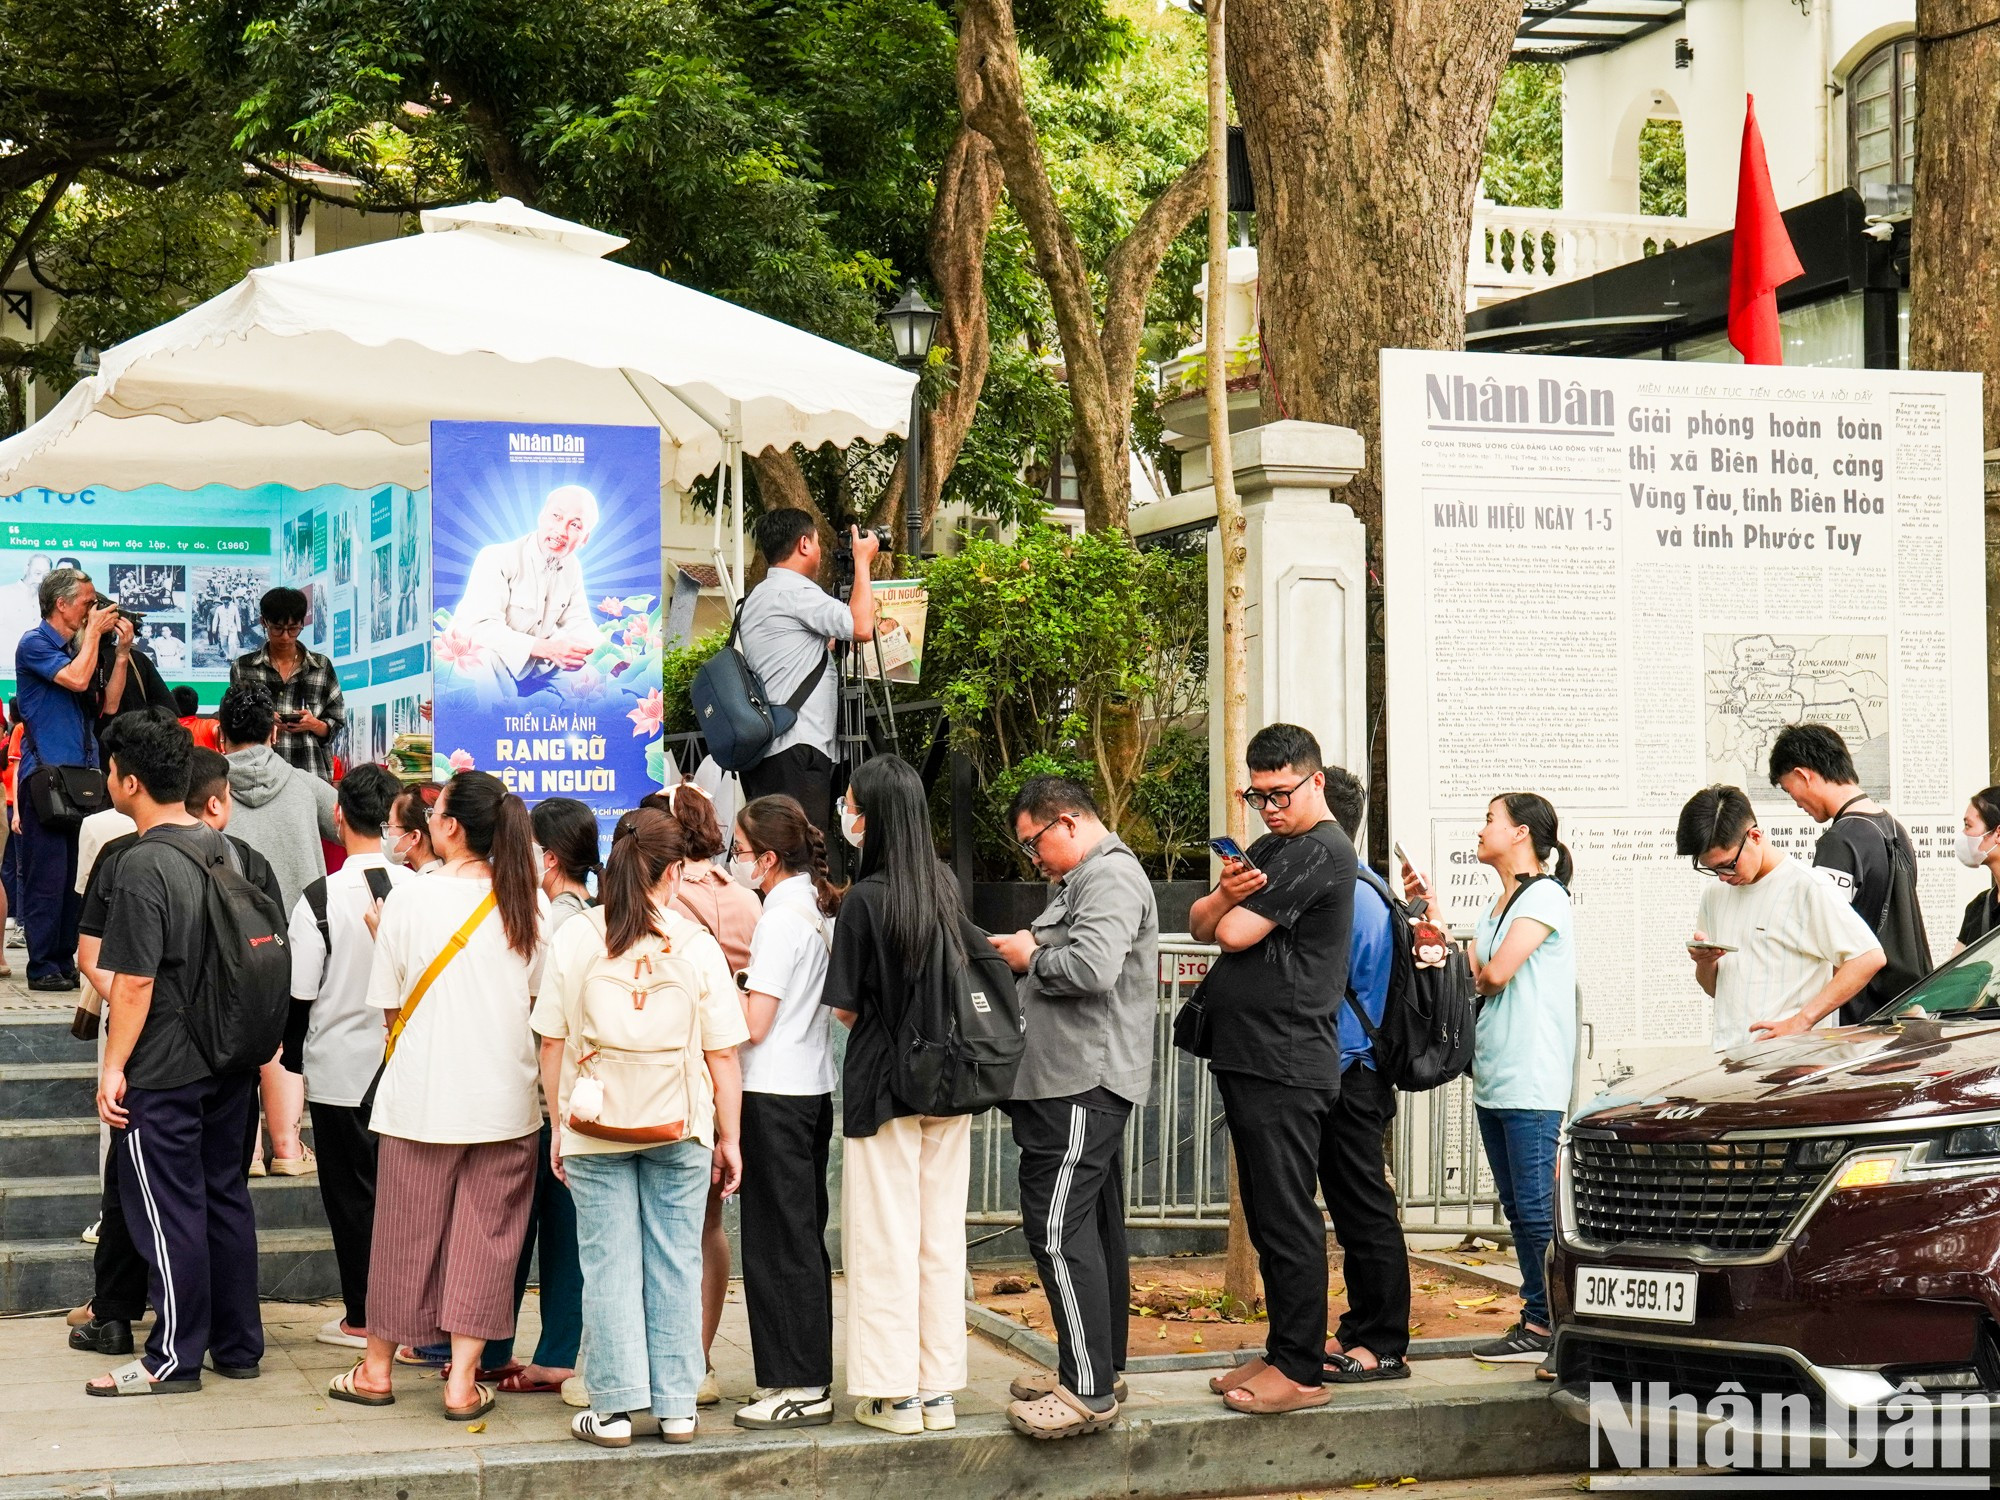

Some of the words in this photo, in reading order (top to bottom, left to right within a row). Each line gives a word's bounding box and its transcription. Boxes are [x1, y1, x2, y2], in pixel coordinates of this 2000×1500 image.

[1426, 373, 1529, 423] Nhân
[1539, 378, 1614, 426] Dân
[1628, 406, 1671, 433] Giải
[1687, 409, 1754, 440] phóng
[1769, 412, 1821, 439] hoàn
[1837, 415, 1883, 440] toàn
[509, 433, 552, 452] Nhân
[553, 434, 584, 452] Dân
[1458, 441, 1482, 449] TRUNG
[1629, 445, 1655, 474] thị
[1670, 450, 1698, 471] xã
[1710, 447, 1758, 473] Biên
[1771, 449, 1819, 480] Hòa,
[1832, 453, 1884, 482] cảng
[1629, 483, 1686, 515] Vũng
[1692, 485, 1738, 516] Tàu,
[1743, 487, 1782, 513] tỉnh
[1790, 488, 1836, 514] Biên
[1843, 489, 1885, 515] Hòa
[1488, 503, 1525, 533] HIỆU
[1535, 505, 1574, 530] NGÀY
[1584, 508, 1612, 531] 1-5
[10, 537, 40, 548] Không
[45, 538, 57, 549] có
[62, 538, 74, 549] gì
[103, 538, 120, 549] hơn
[126, 539, 143, 550] độc
[177, 539, 189, 550] tự
[217, 540, 250, 551] (1966)
[1656, 526, 1682, 547] và
[1693, 524, 1733, 549] tỉnh
[1743, 524, 1815, 550] Phước
[1825, 525, 1862, 556] Tuy
[504, 711, 539, 732] TRIỂN
[543, 714, 568, 732] LÃM
[571, 713, 596, 732] ẢNH
[496, 738, 566, 764] RẠNG
[571, 735, 607, 761] RỠ
[541, 766, 616, 792] NGƯỜI
[1451, 871, 1491, 885] BIÊN
[1586, 1276, 1685, 1312] 30K-589.13
